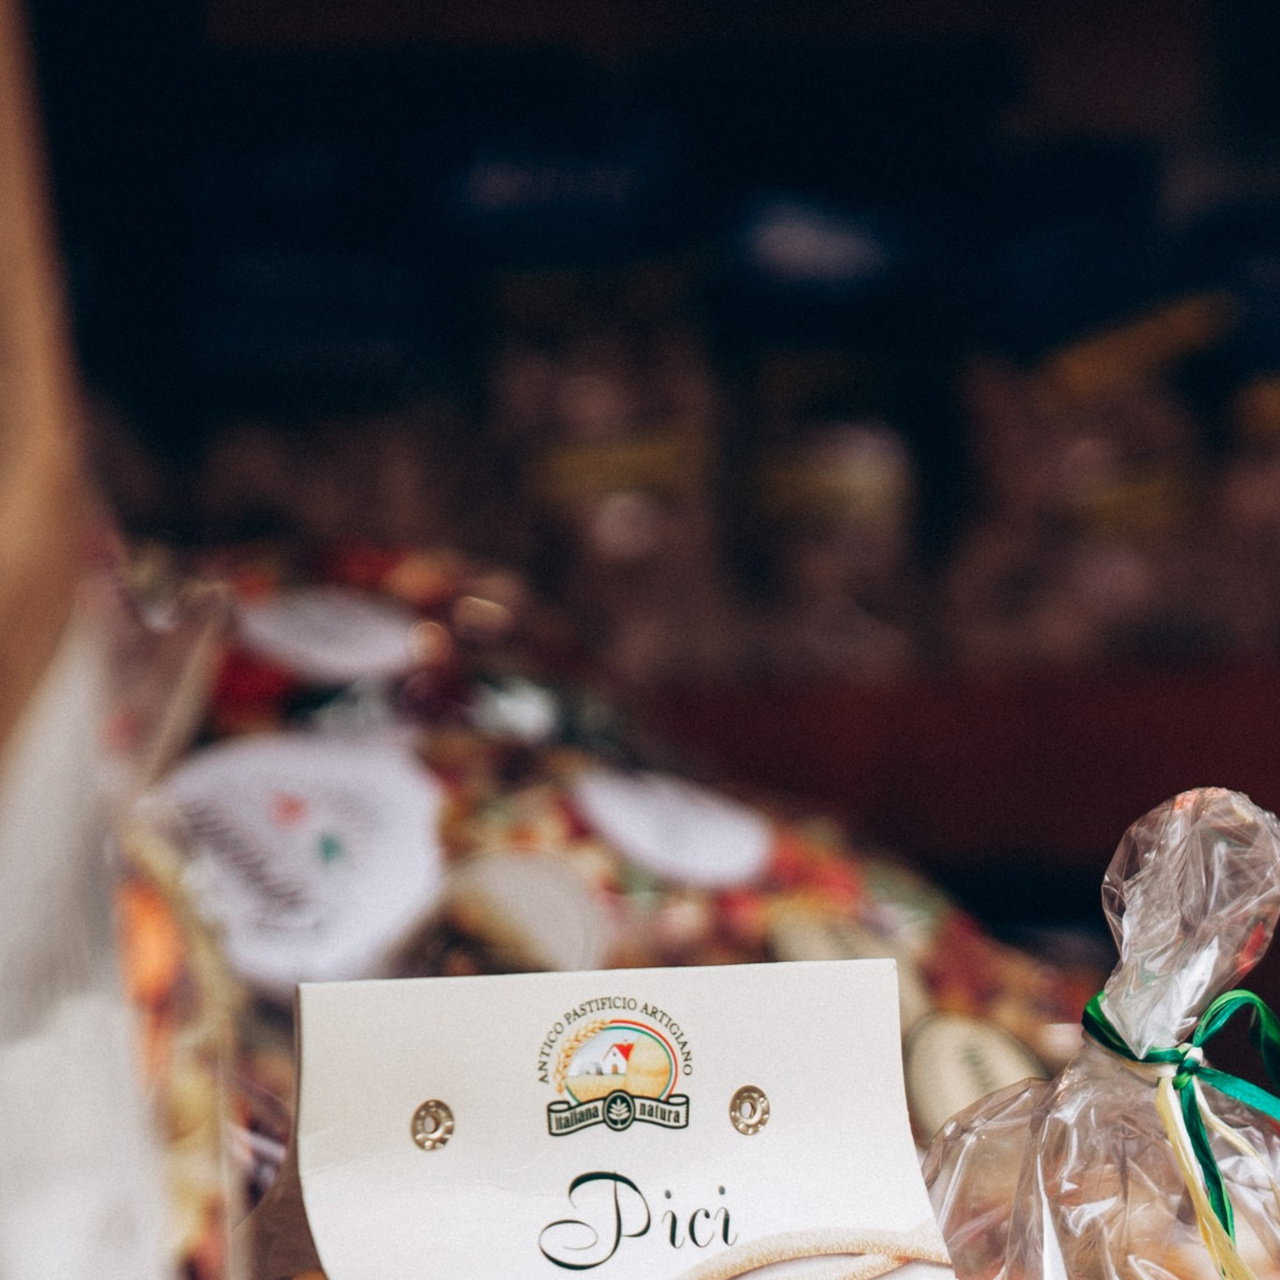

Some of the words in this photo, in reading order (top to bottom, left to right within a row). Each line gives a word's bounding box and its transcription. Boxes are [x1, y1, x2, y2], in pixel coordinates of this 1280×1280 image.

[537, 1021, 565, 1084] ANTICO
[563, 996, 638, 1025] PASTIFICIO
[640, 1002, 694, 1077] ARTIGIANO
[639, 1102, 681, 1124] natura
[538, 1170, 738, 1271] Pici
